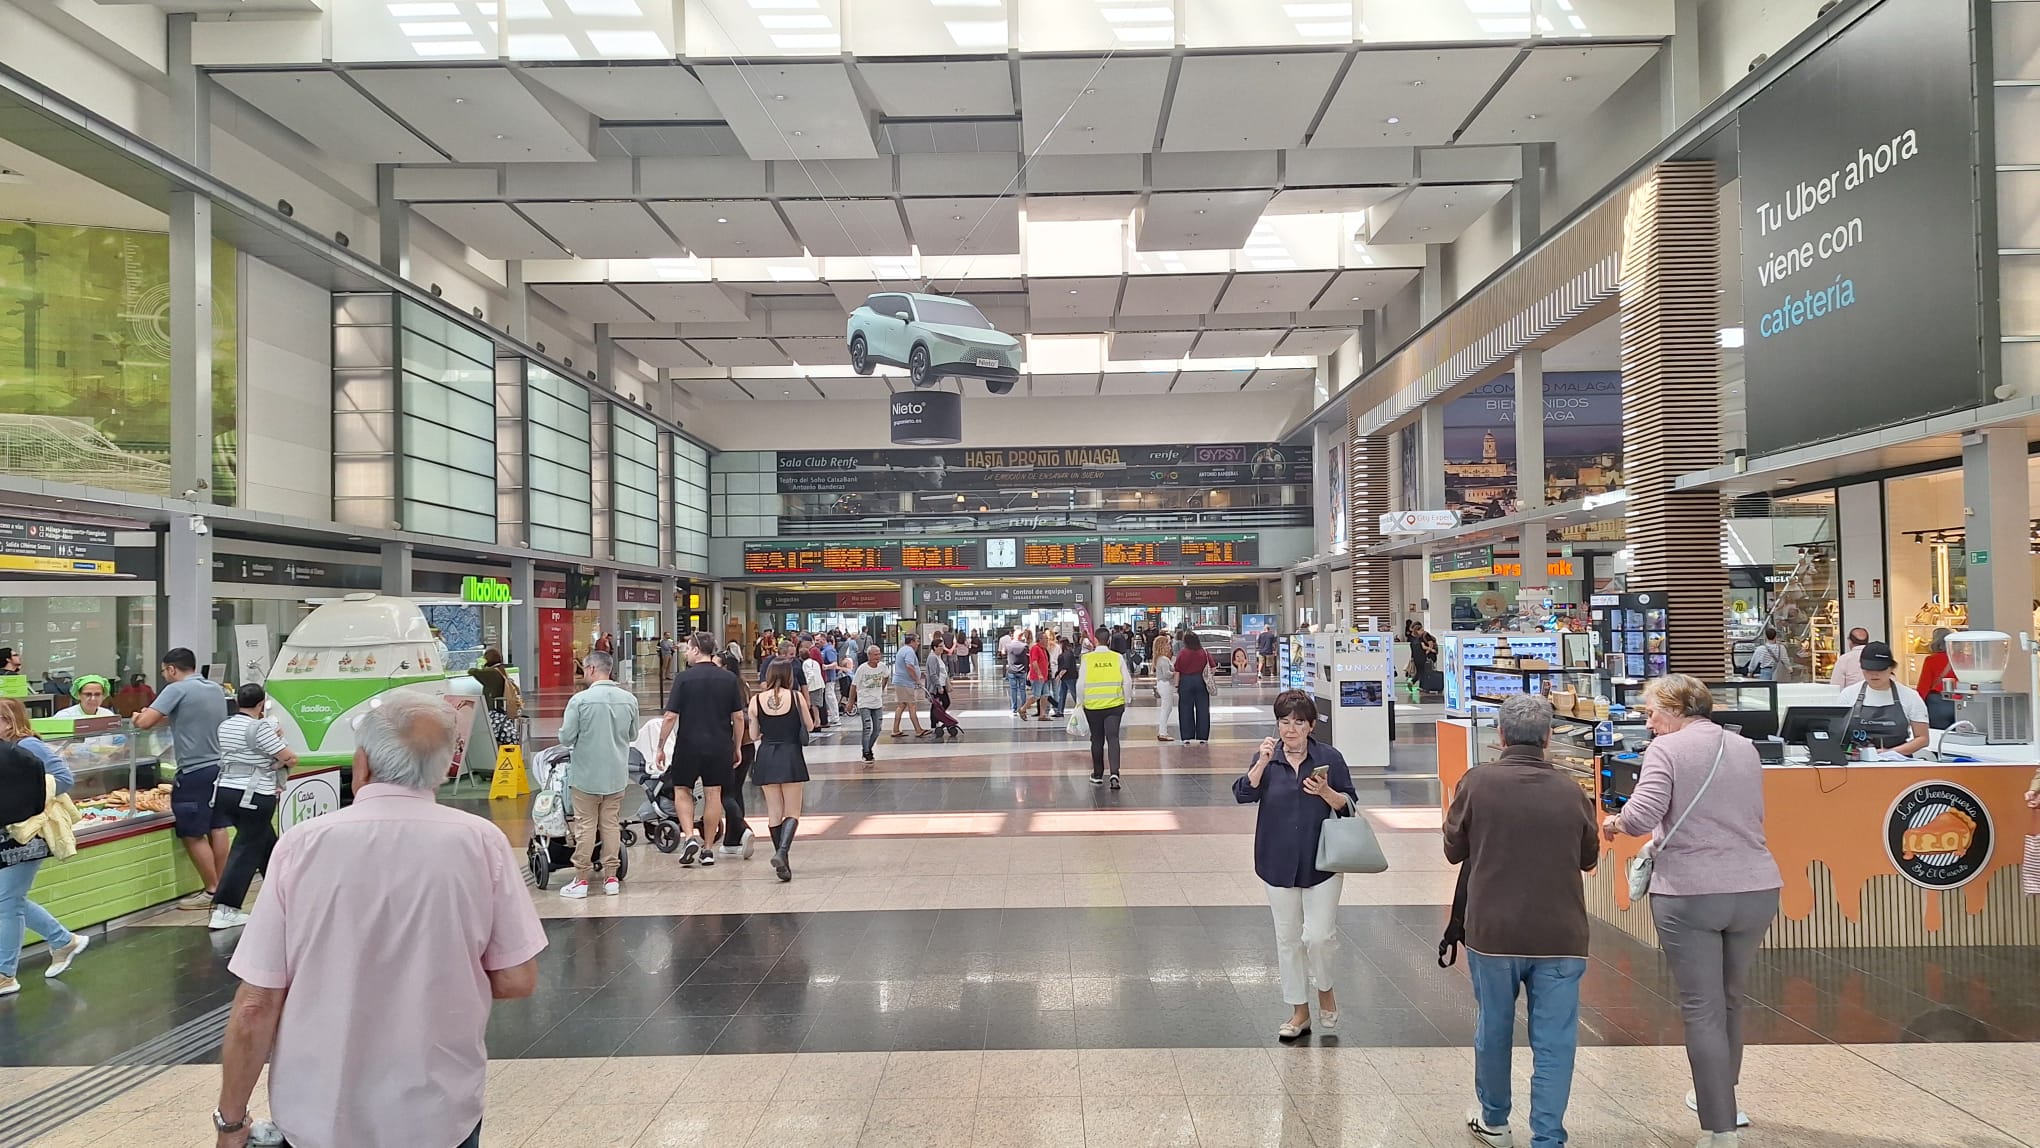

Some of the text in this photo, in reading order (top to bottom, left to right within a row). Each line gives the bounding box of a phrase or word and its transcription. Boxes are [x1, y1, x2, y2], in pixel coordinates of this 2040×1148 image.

[1756, 128, 1919, 236] Tu Uber ahora
[1757, 217, 1863, 288] viene con
[1760, 274, 1856, 338] cafetería
[892, 402, 923, 416] Nieto
[1486, 398, 1589, 410] BIENNIDOS
[1499, 412, 1510, 422] A
[779, 455, 858, 468] Sala Club Renfe
[964, 447, 1120, 468] HASTA PRONTO MÁLAGA
[1149, 450, 1179, 461] renfe
[1199, 449, 1241, 461] GYPSY
[779, 476, 799, 484] Teatro
[799, 476, 809, 484] del
[826, 475, 858, 484] CaixaBank
[1008, 515, 1047, 530] renfe
[934, 591, 952, 601] 1-8
[1044, 589, 1073, 597] equipajes
[297, 790, 315, 803] Casa
[1896, 801, 1916, 821] La
[1926, 868, 1937, 878] El
